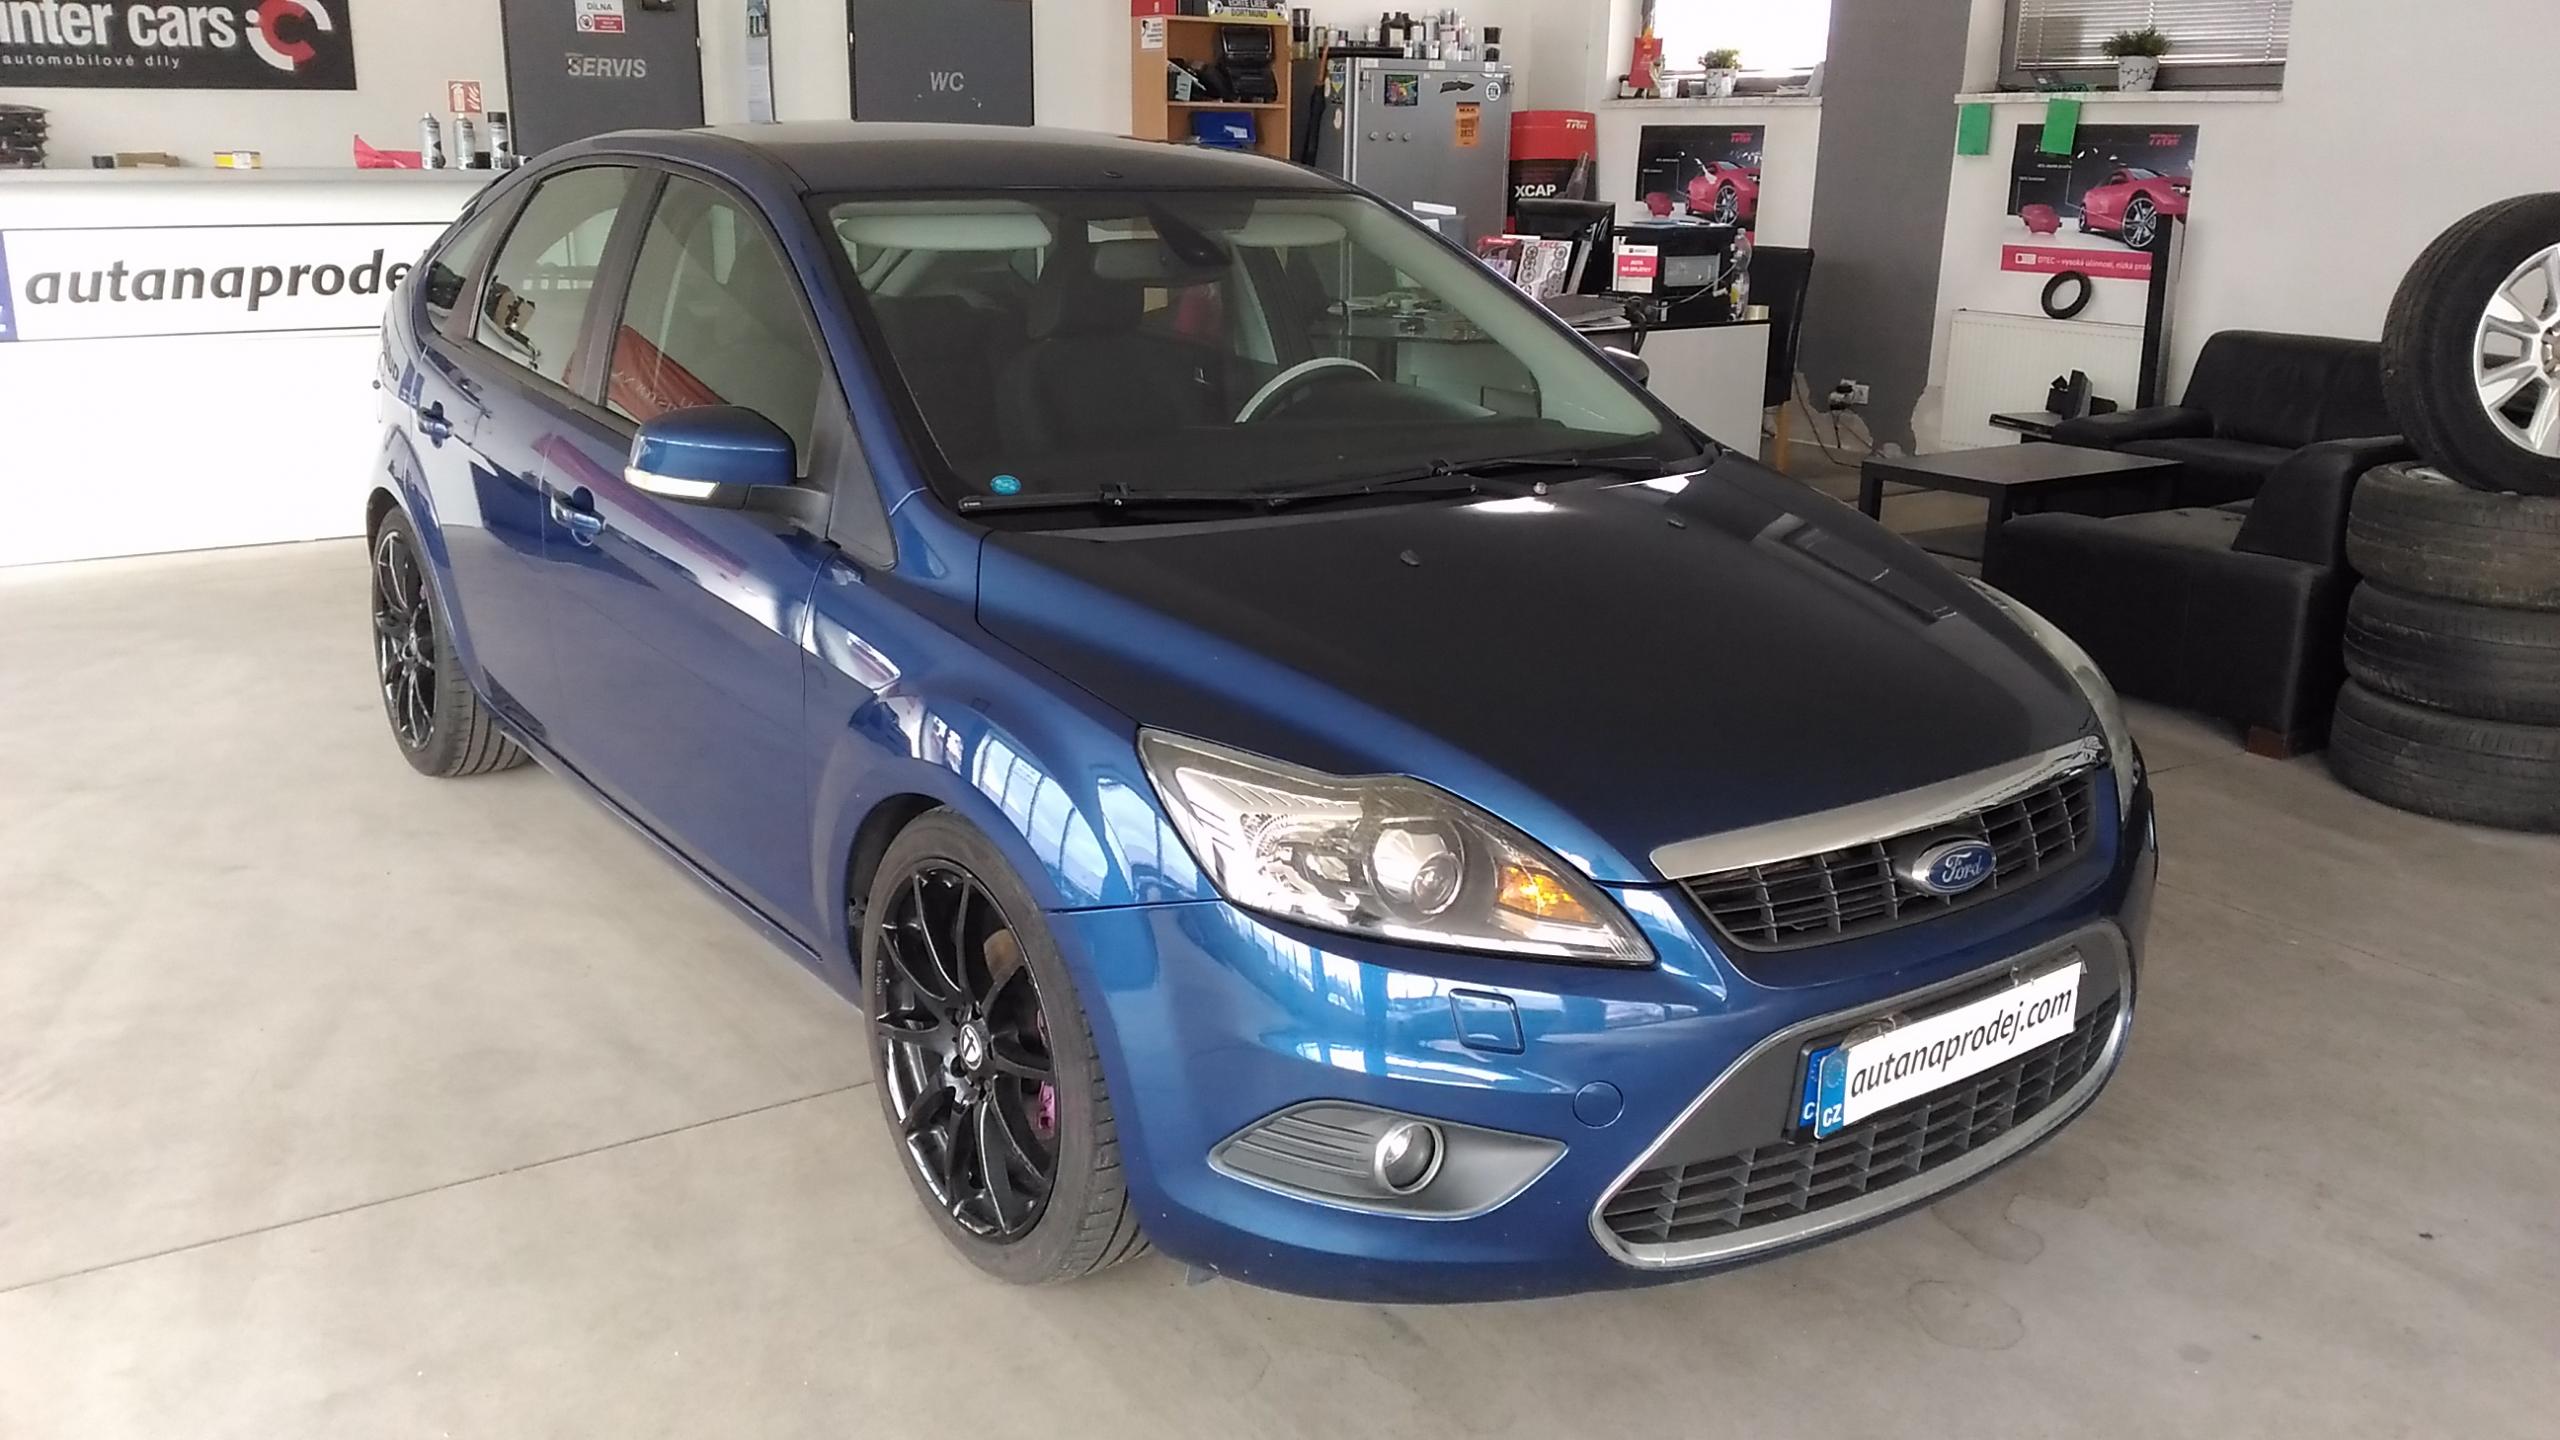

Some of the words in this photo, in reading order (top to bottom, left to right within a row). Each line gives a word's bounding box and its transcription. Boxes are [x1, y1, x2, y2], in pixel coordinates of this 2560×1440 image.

[127, 4, 237, 48] cars
[2, 52, 135, 67] automobilové
[145, 52, 181, 69] díly
[566, 57, 647, 78] SERVIS
[930, 71, 965, 92] WC
[1514, 184, 1557, 198] XCAP
[1942, 851, 1983, 883] Ford
[1850, 988, 2072, 1099] autanaprodej.com
[1822, 1105, 1842, 1128] CZ
